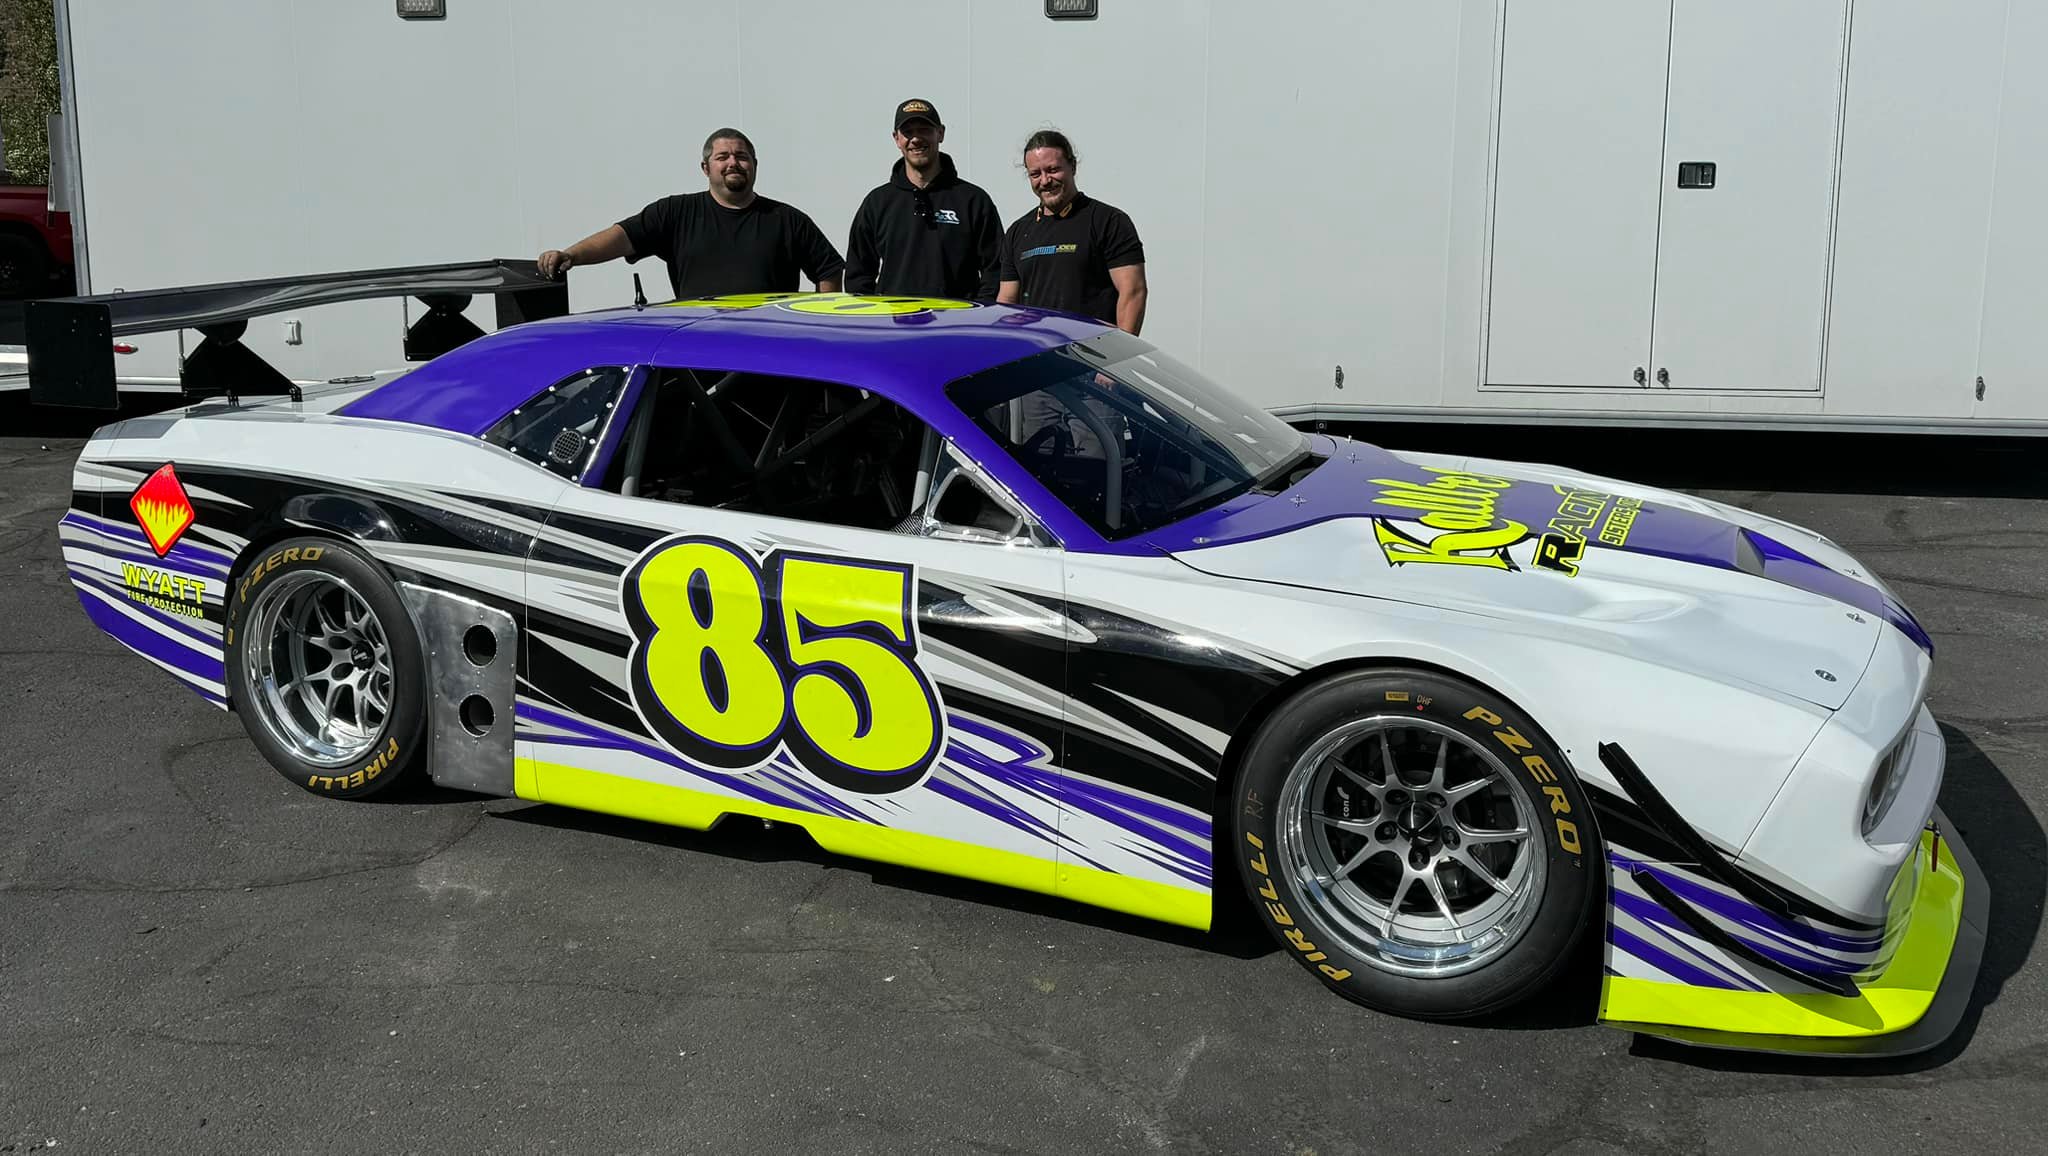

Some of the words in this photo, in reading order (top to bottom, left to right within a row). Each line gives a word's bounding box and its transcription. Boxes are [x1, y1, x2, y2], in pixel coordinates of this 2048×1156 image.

[1532, 485, 1611, 577] RACIN
[121, 562, 206, 604] WYATT
[127, 589, 146, 603] FIRE
[148, 595, 204, 619] PROTECTION
[620, 534, 946, 796] 85
[308, 736, 399, 790] PIRELLI
[1462, 705, 1582, 855] PZERO
[1246, 831, 1352, 982] PIRELLI
